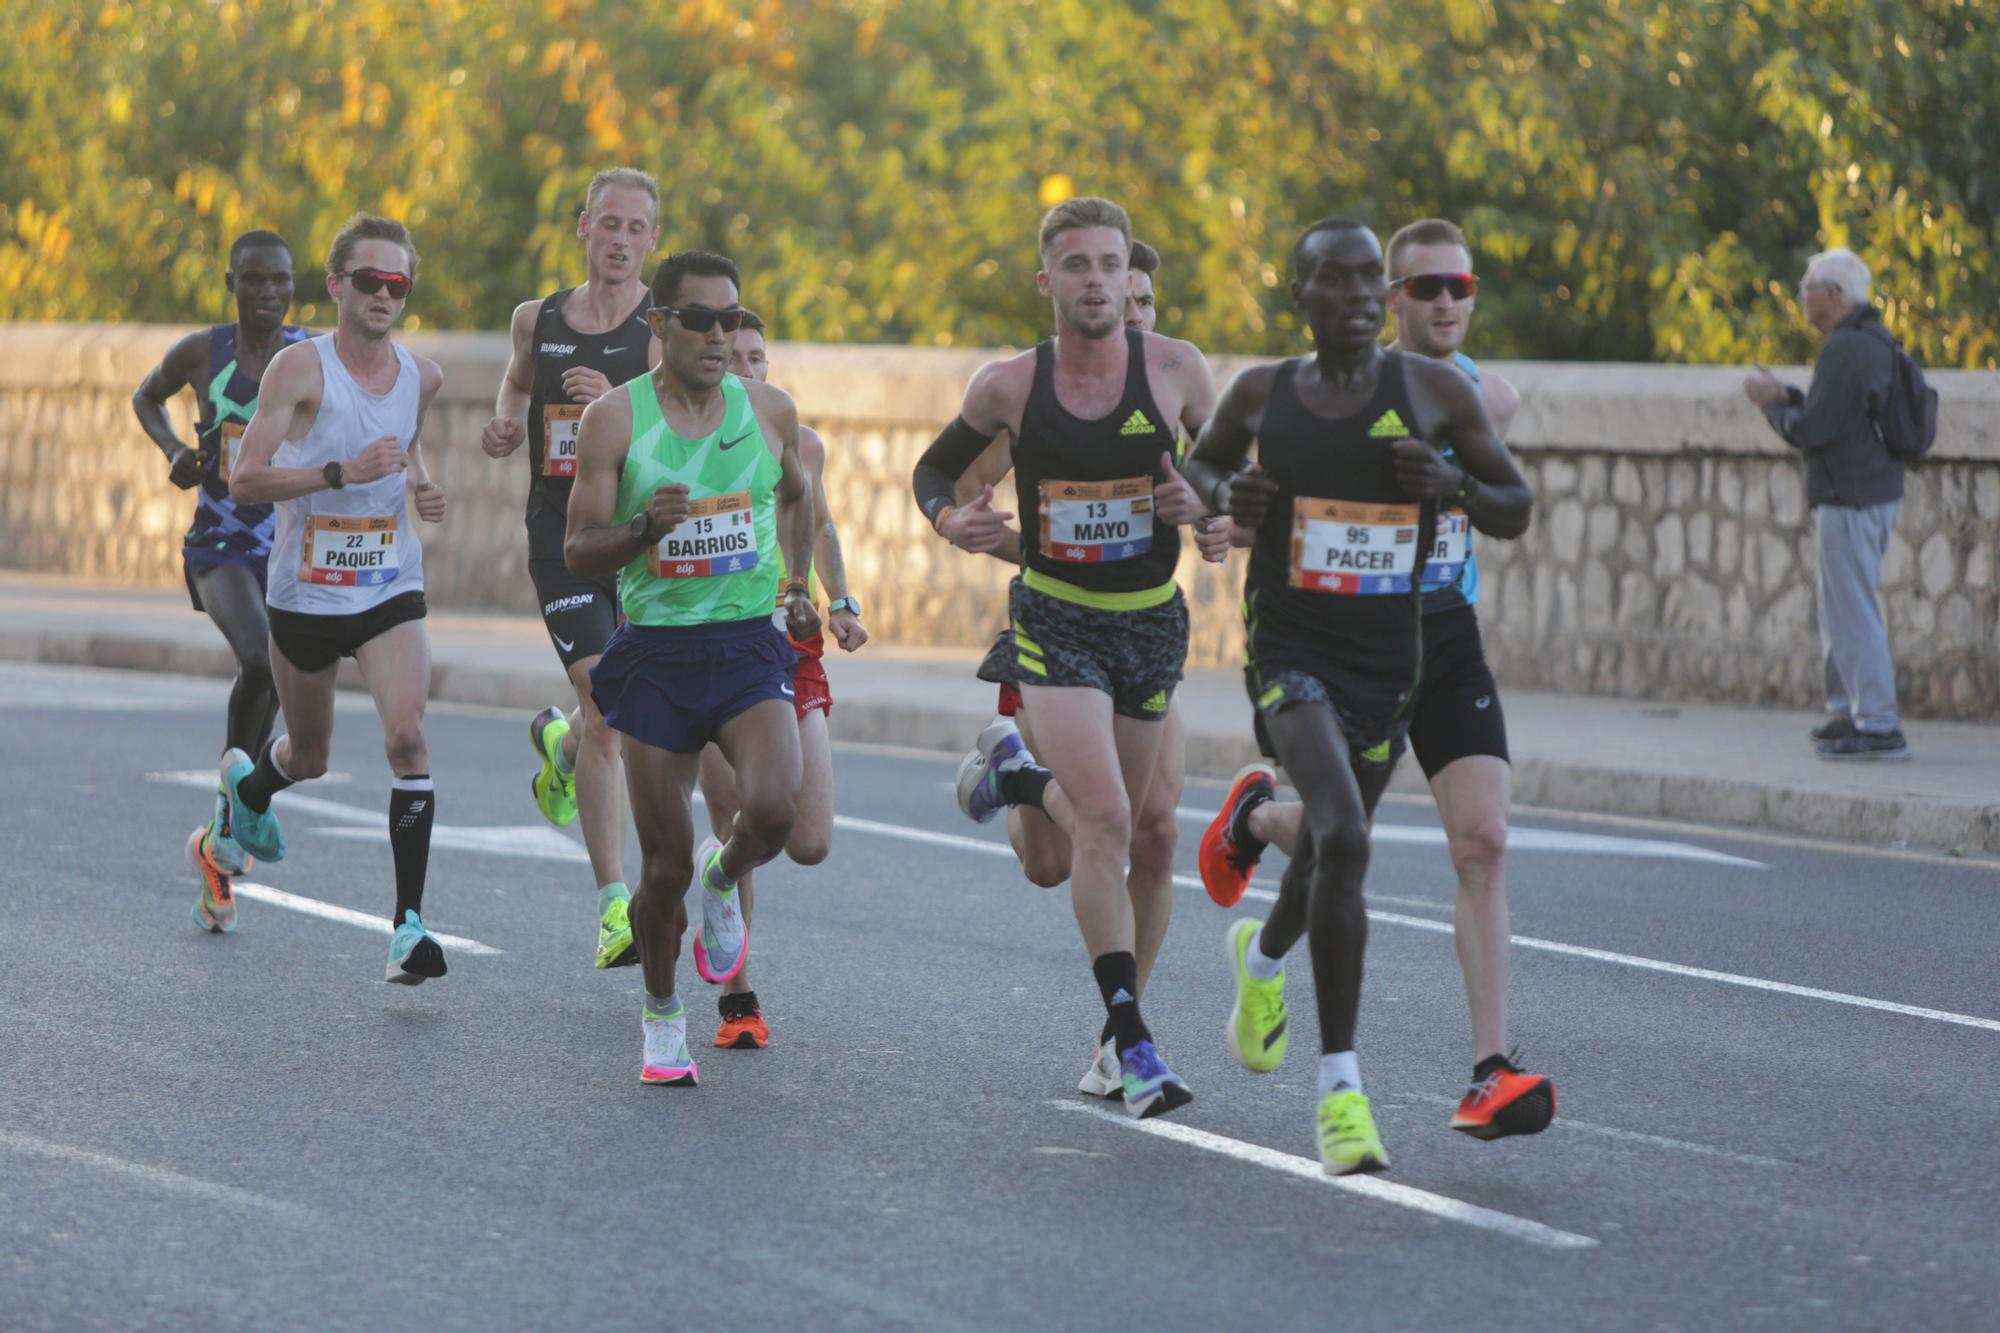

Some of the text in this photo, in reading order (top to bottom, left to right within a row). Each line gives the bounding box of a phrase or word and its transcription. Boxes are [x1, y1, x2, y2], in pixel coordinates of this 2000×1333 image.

[1120, 424, 1156, 435] adidas
[1086, 503, 1107, 518] 13
[694, 518, 713, 534] 15
[1074, 521, 1129, 541] MAYO
[346, 535, 364, 548] 22
[1346, 527, 1370, 544] 95
[667, 532, 748, 557] BARRIOS
[325, 550, 386, 568] PAQUET
[1326, 548, 1395, 569] PACER
[325, 571, 343, 583] edp
[676, 563, 695, 575] edp
